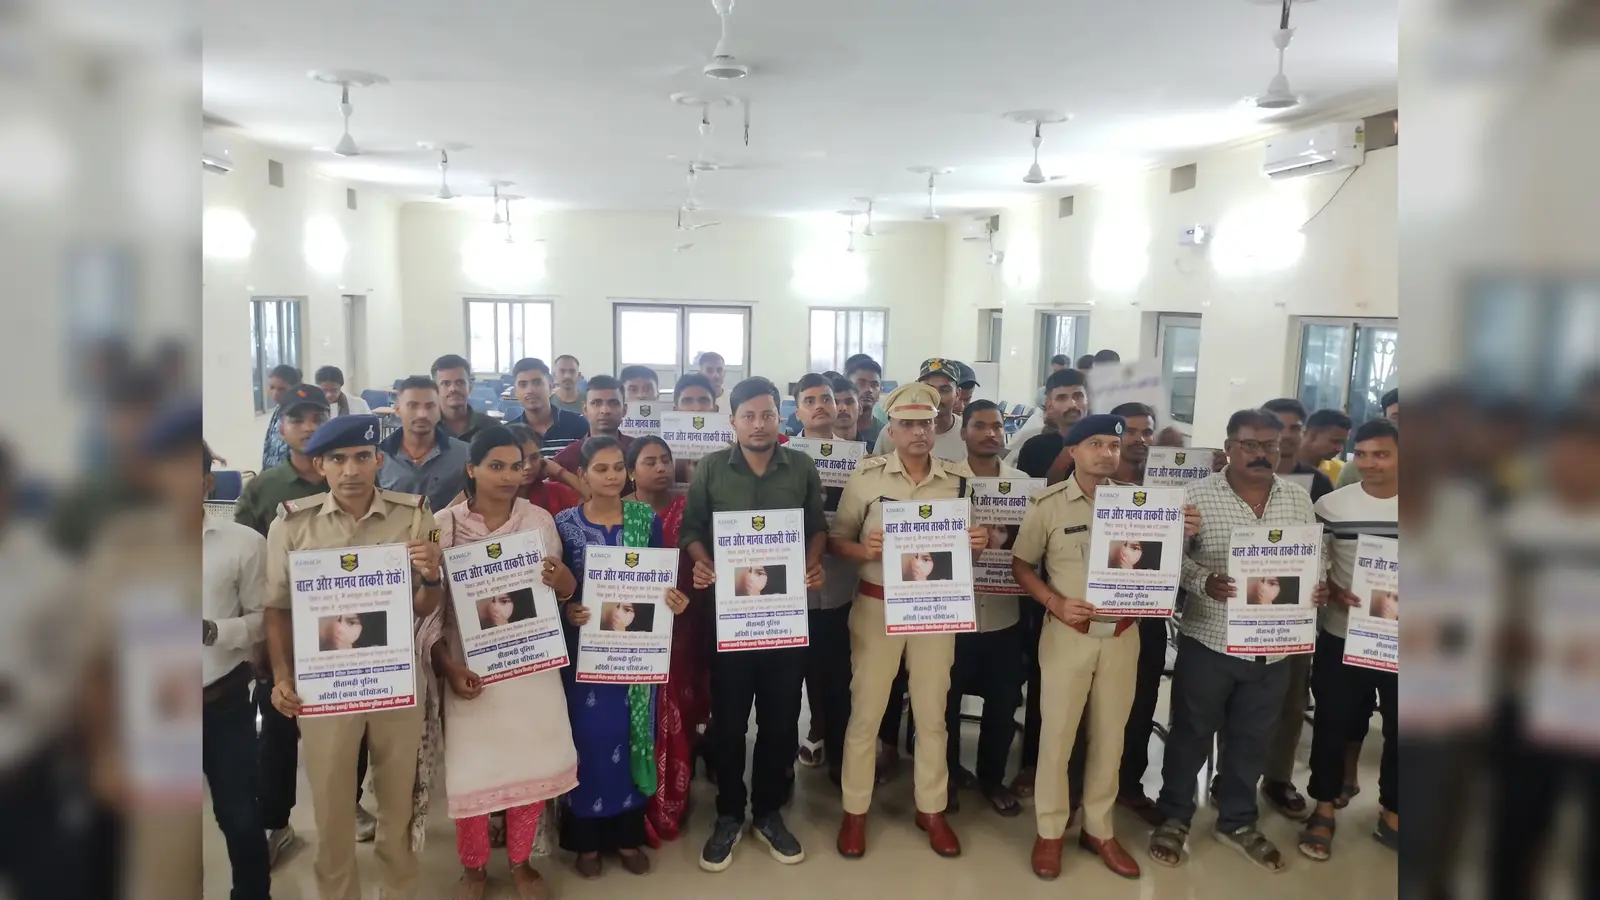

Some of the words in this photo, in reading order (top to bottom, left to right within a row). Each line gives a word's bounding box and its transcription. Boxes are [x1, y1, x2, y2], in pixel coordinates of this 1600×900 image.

[1097, 509, 1109, 520] बाल
[1126, 510, 1142, 520] मानव
[1144, 508, 1164, 520] तस्करी
[886, 524, 898, 533] बाल
[913, 523, 930, 532] मानव
[931, 518, 950, 531] तस्करी
[718, 536, 731, 546] बाल
[746, 534, 763, 545] मानव
[764, 531, 784, 544] तस्करी
[1232, 547, 1245, 556] बाल
[1261, 546, 1278, 556] मानव
[1280, 544, 1299, 556] तस्करी
[452, 569, 467, 582] बाल
[484, 561, 502, 574] मानव
[504, 555, 525, 571] तस्करी
[1359, 557, 1373, 568] बाल
[295, 580, 313, 592] बाल
[334, 576, 356, 588] मानव
[359, 571, 384, 587] तस्करी
[589, 570, 601, 579] बाल
[618, 571, 634, 581] मानव
[636, 570, 656, 582] तस्करी
